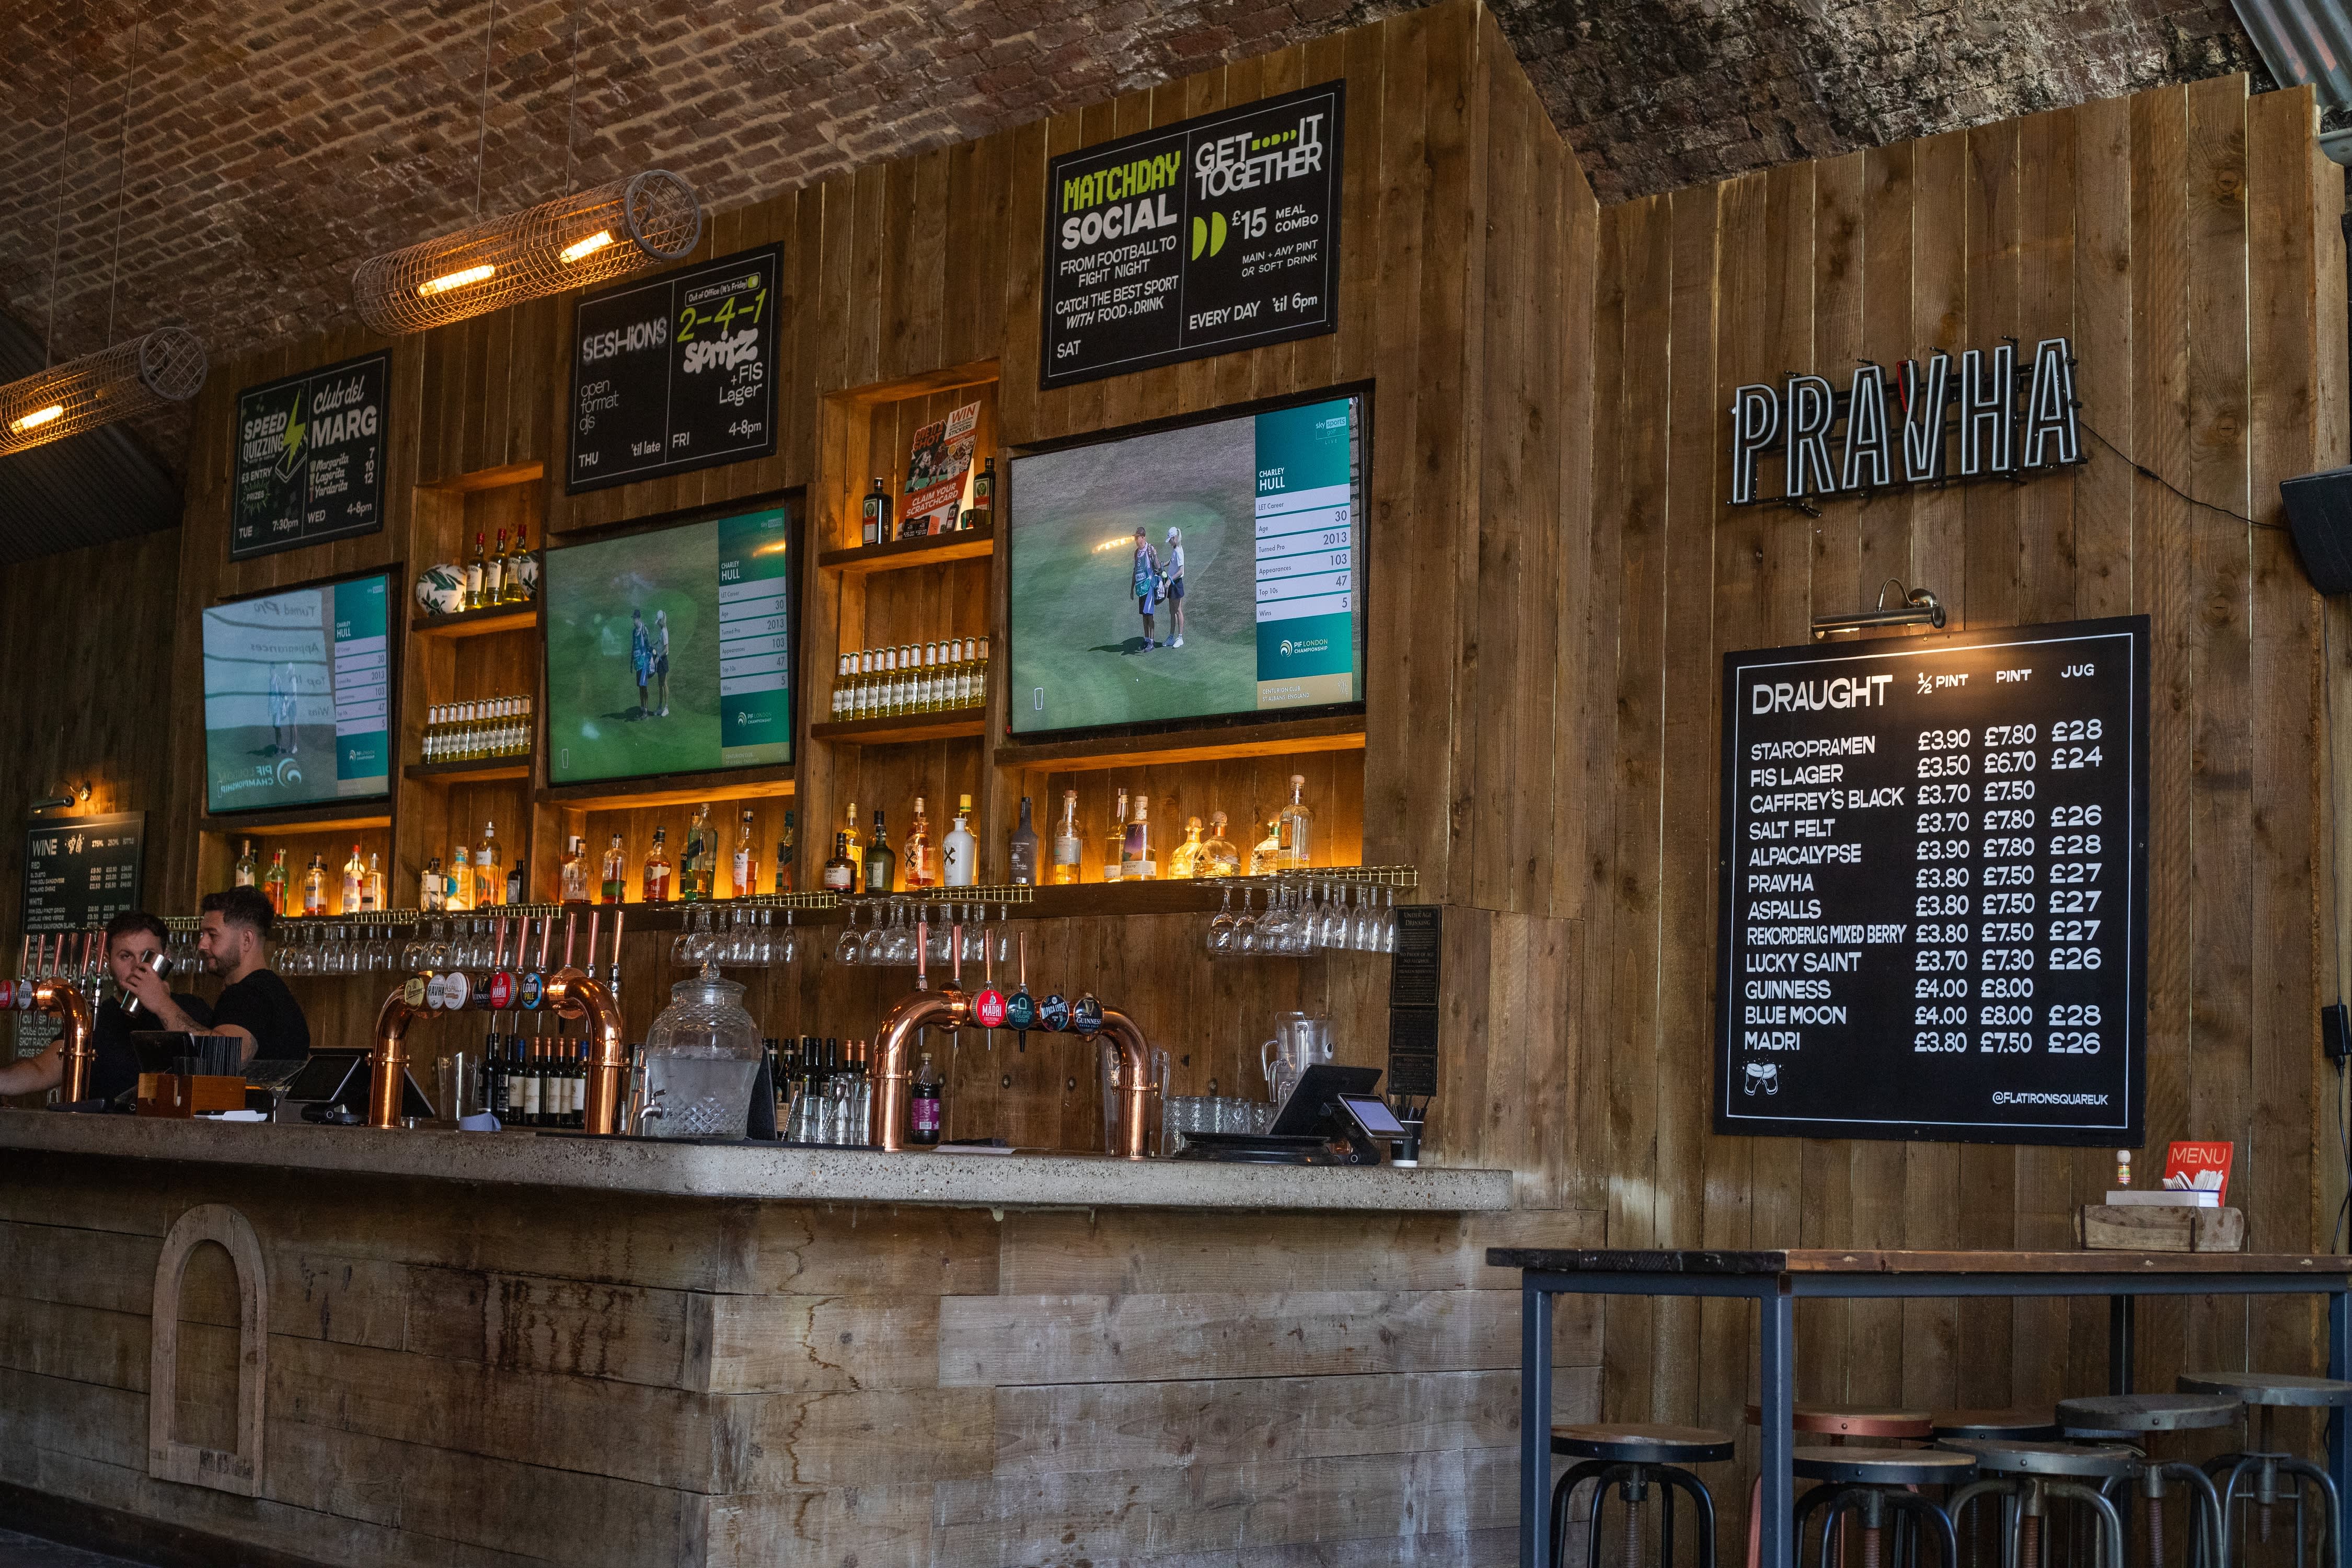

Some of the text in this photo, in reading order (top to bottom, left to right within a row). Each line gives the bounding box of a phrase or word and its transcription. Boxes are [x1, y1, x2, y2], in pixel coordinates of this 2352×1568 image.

[1195, 113, 1323, 173] GET IT
[1063, 151, 1181, 213] MATCHDAY
[1195, 143, 1323, 200] TOGETHER
[1062, 194, 1177, 250] SOCIAL
[1232, 204, 1305, 239] £15 MEAL
[1275, 214, 1318, 233] COMBO
[1060, 235, 1176, 275] FROM FOOTBALL TO
[1242, 239, 1318, 264] MAIN ANY PINT
[1079, 258, 1150, 287] FIGHT NIGHT
[1242, 253, 1317, 277] OR SOFT DRINK
[705, 287, 719, 298] Office
[731, 279, 748, 293] Friday)
[1056, 275, 1179, 315] CATCH THE BEST SPORT
[677, 288, 767, 343] 2-4-1
[1066, 312, 1095, 329] WITH
[1190, 307, 1231, 330] EVERY
[1233, 301, 1261, 321] DAY
[1292, 292, 1318, 311] 6pm
[1057, 340, 1081, 358] SAT
[739, 362, 763, 384] FIS
[314, 375, 365, 415] Club del
[581, 379, 610, 398] open
[719, 384, 763, 406] Lager
[581, 391, 619, 414] format
[952, 404, 976, 423] WIN
[244, 411, 287, 441] SPEED
[311, 406, 377, 449] MARG
[580, 414, 595, 435] djs
[1733, 337, 2080, 505] PRAVHA
[672, 420, 762, 448] FRI 4-8pm
[243, 433, 284, 463] QUIZZING
[316, 447, 375, 472] Margarita 7
[579, 452, 598, 468] THU
[644, 441, 661, 455] late
[241, 466, 272, 483] £3 ENTRY
[315, 459, 374, 485] Lagerita 10
[1259, 467, 1285, 478] CHARLEY
[1260, 476, 1285, 491] HULL
[246, 490, 264, 502] PRIZES
[315, 472, 373, 499] Yardarita 12
[912, 490, 935, 506] CLAIM
[937, 482, 956, 495] YOUR
[307, 502, 372, 523] WED 4-8pm
[906, 490, 959, 517] SCRATCHCARD
[1335, 510, 1347, 522] 30
[239, 518, 298, 539] TUE 7:30pm
[1323, 532, 1347, 545] 2013
[721, 560, 740, 569] CHARLEY
[721, 568, 740, 581] HULL
[1259, 554, 1347, 575] Appearances 103
[1336, 575, 1347, 586] 47
[1342, 597, 1347, 608] 5
[1294, 645, 1328, 654] CHAMPIONSHIP
[1303, 638, 1328, 647] LONDON
[1753, 674, 1893, 714] DRAUGHT
[1936, 674, 1969, 688] PINT
[1996, 668, 2032, 683] PINT
[2061, 663, 2094, 678] JUG
[1751, 719, 2103, 760] STAROPRAMEN £3.90 £7.80 £28
[1750, 745, 2103, 787] FIS LAGER £3.50 £6.70 £24
[1750, 780, 2035, 813] CAFFREY'S BLACK £3.70 £7.50
[1749, 804, 2102, 840] SALT FELT £3.70 £7.80 £26
[32, 838, 57, 857] WINE
[1749, 834, 2102, 866] ALPACALYPSE £3.90 £7.80 £28
[1748, 862, 2102, 893] PRAVHA £3.80 £7.50 £27
[1748, 891, 2102, 920] ASPALLS £3.80 £7.50 £27
[1747, 920, 2101, 945] REKORDERLIG MIXED BERRY £3.80 £7.50 £27
[1746, 947, 2102, 972] LUCKY SAINT £3.70 £7.30 £26
[523, 983, 537, 993] LOOM
[524, 992, 535, 1000] PALE
[1745, 977, 2034, 999] GUINNESS £4.00 £8.00
[1745, 1005, 2102, 1026] BLUE MOON £4.00 £8.00 £28
[1744, 1031, 2101, 1054] MADRI £3.80 £7.50 £26
[1992, 1091, 2108, 1105] @FLATIRONSQUAREUK
[2171, 1147, 2227, 1165] MENU
